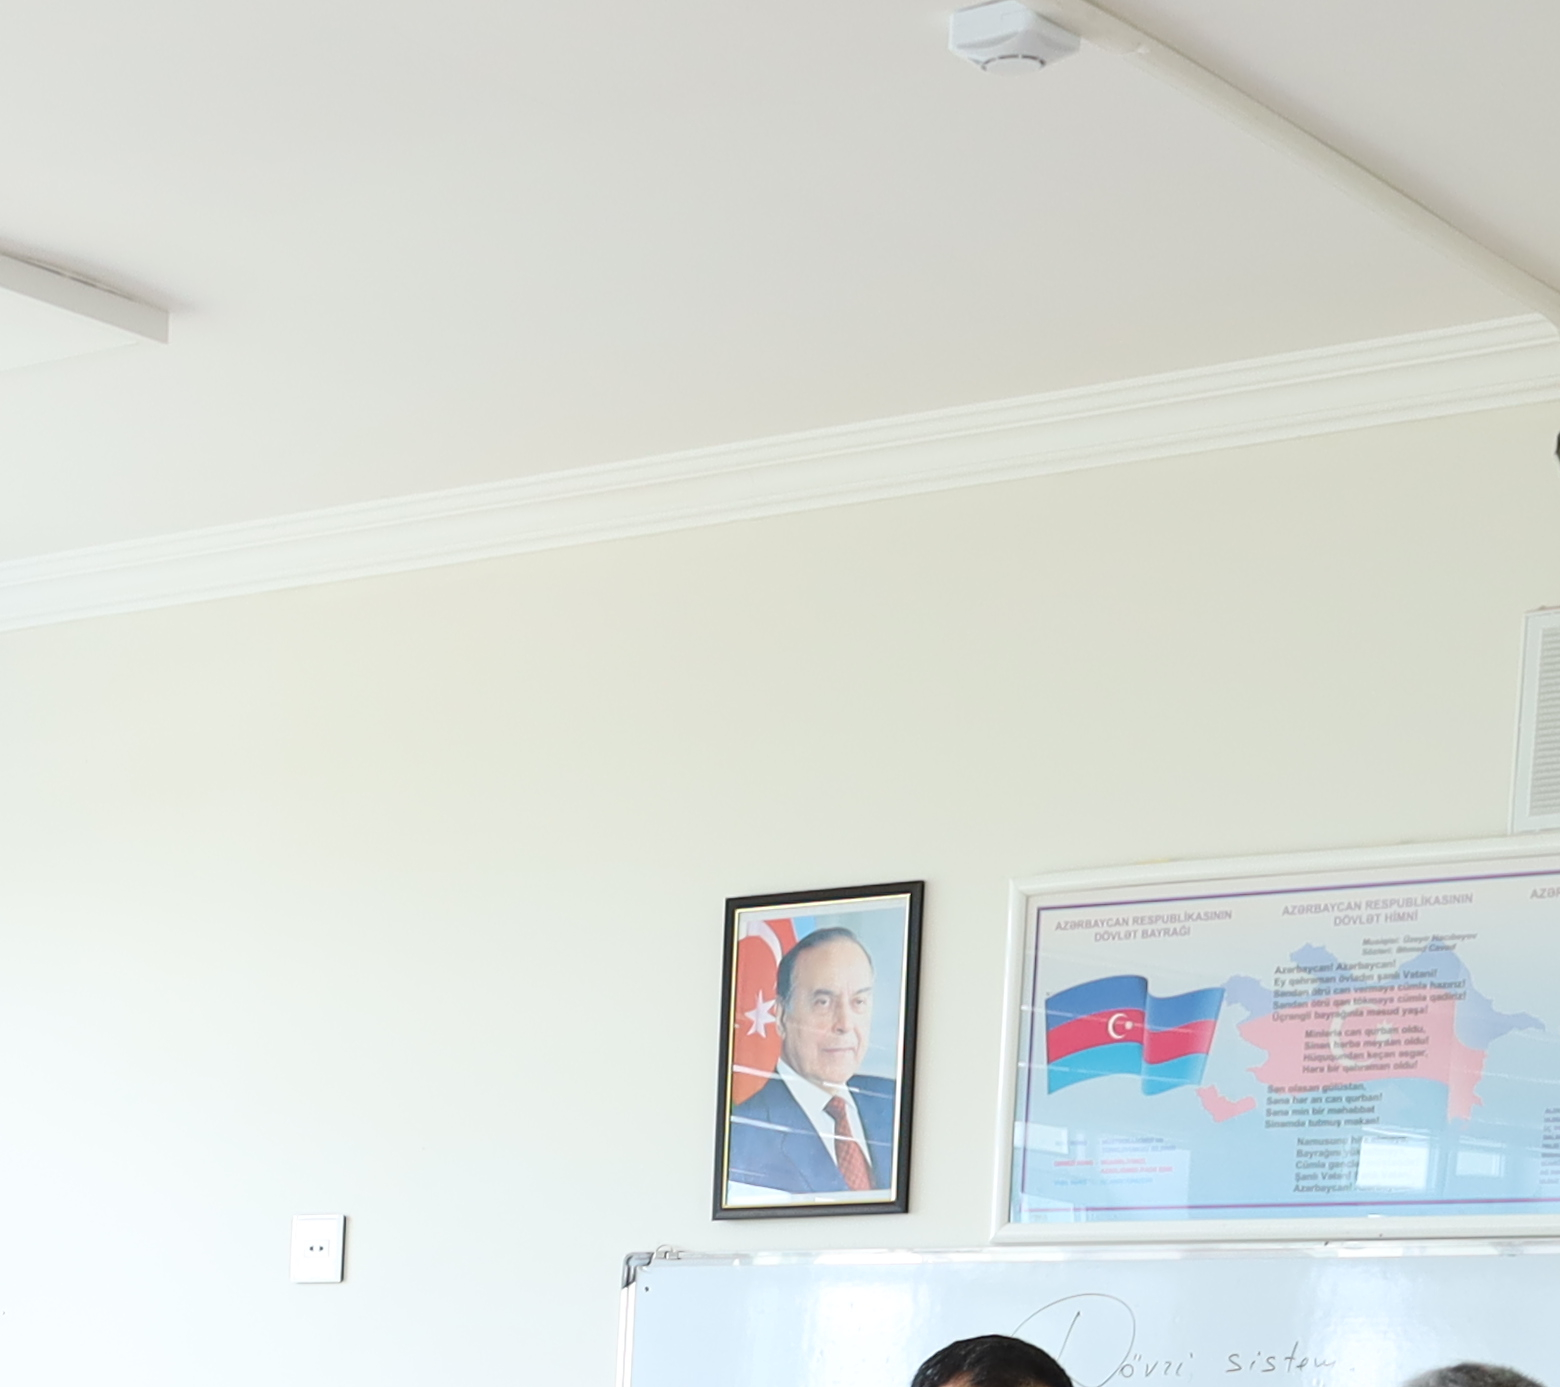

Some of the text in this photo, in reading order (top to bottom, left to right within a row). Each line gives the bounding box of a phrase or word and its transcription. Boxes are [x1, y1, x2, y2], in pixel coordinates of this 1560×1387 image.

[1282, 902, 1361, 916] AZƏRBAYCAN
[1055, 917, 1129, 931] AZƏRBAYCAN
[1334, 910, 1418, 926] DÖVLƏT HİMNİ
[1094, 925, 1190, 942] DÖVLƏT BAYRAĞI
